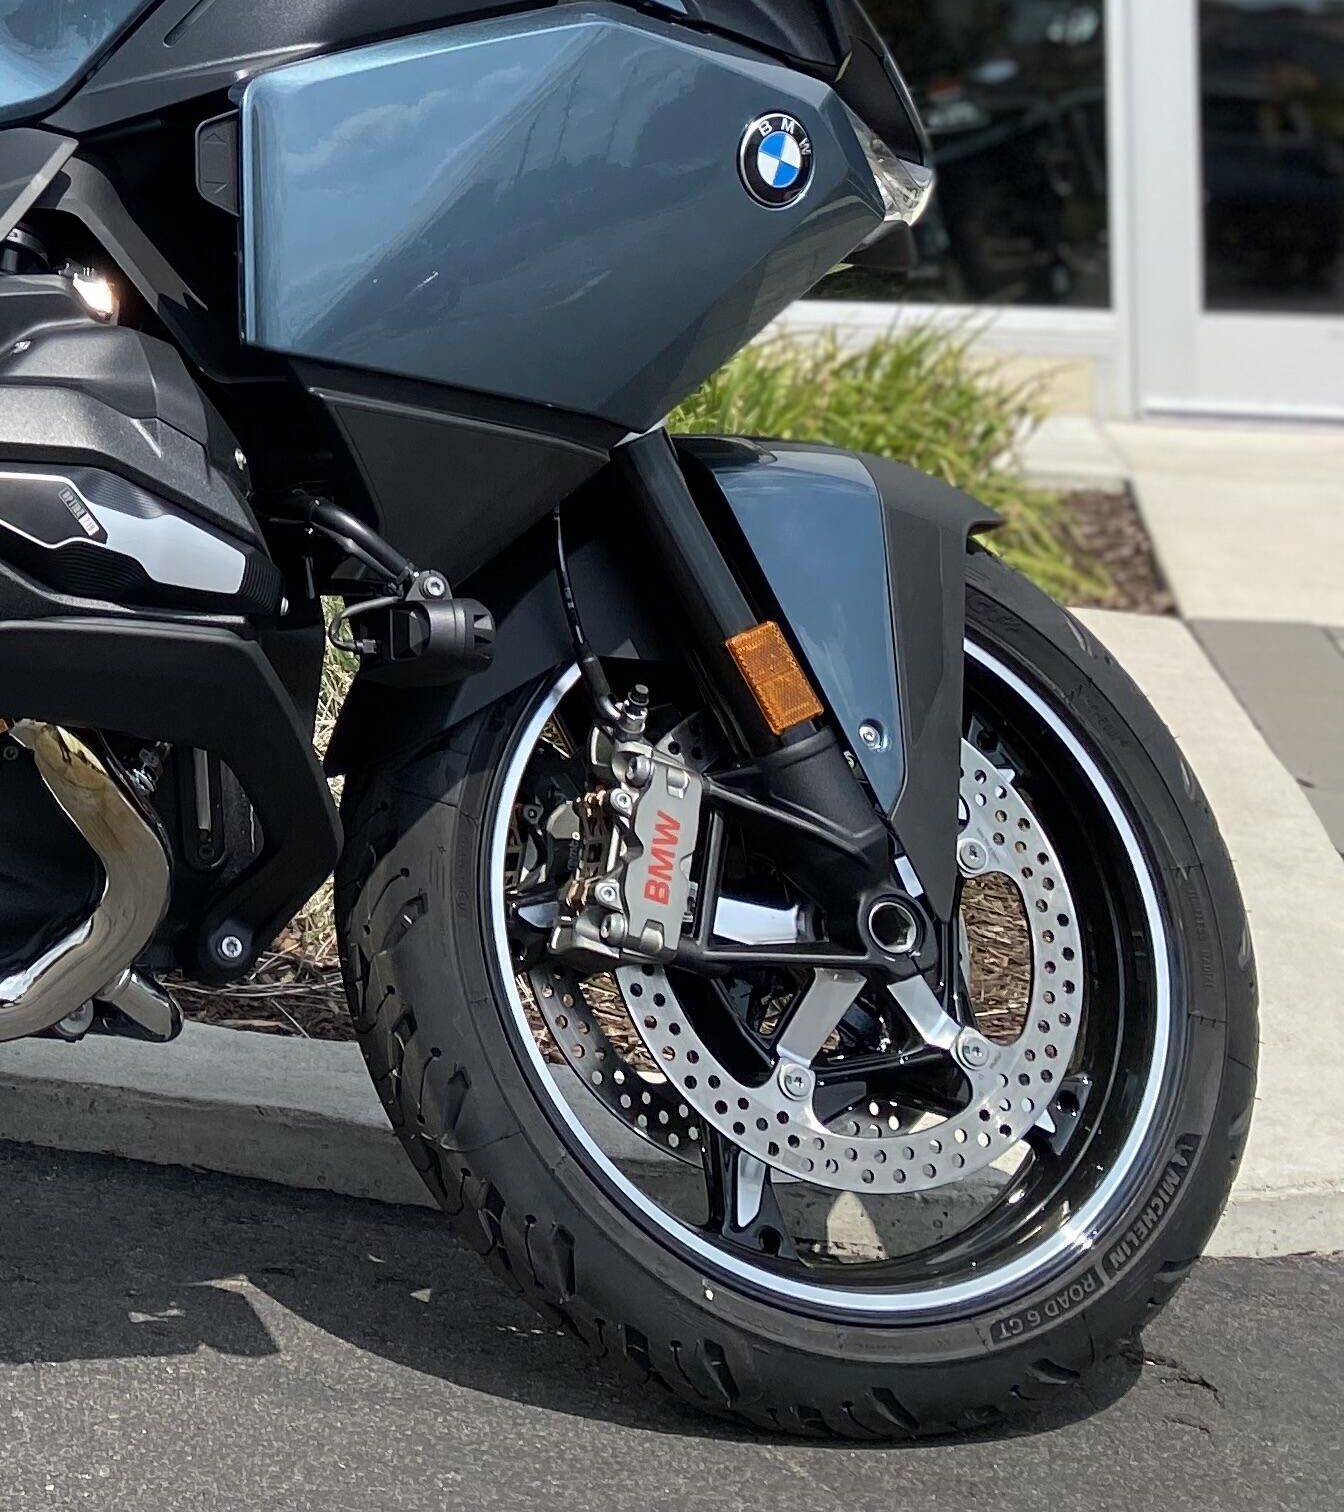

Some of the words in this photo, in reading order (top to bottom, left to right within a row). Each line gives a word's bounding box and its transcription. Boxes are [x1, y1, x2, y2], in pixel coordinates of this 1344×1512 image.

[758, 117, 812, 156] BMW
[643, 810, 683, 906] BMW
[1107, 1166, 1181, 1268] MICHELIN
[1044, 1274, 1097, 1319] ROAD
[998, 1318, 1024, 1339] GT
[1025, 1310, 1041, 1327] 6
